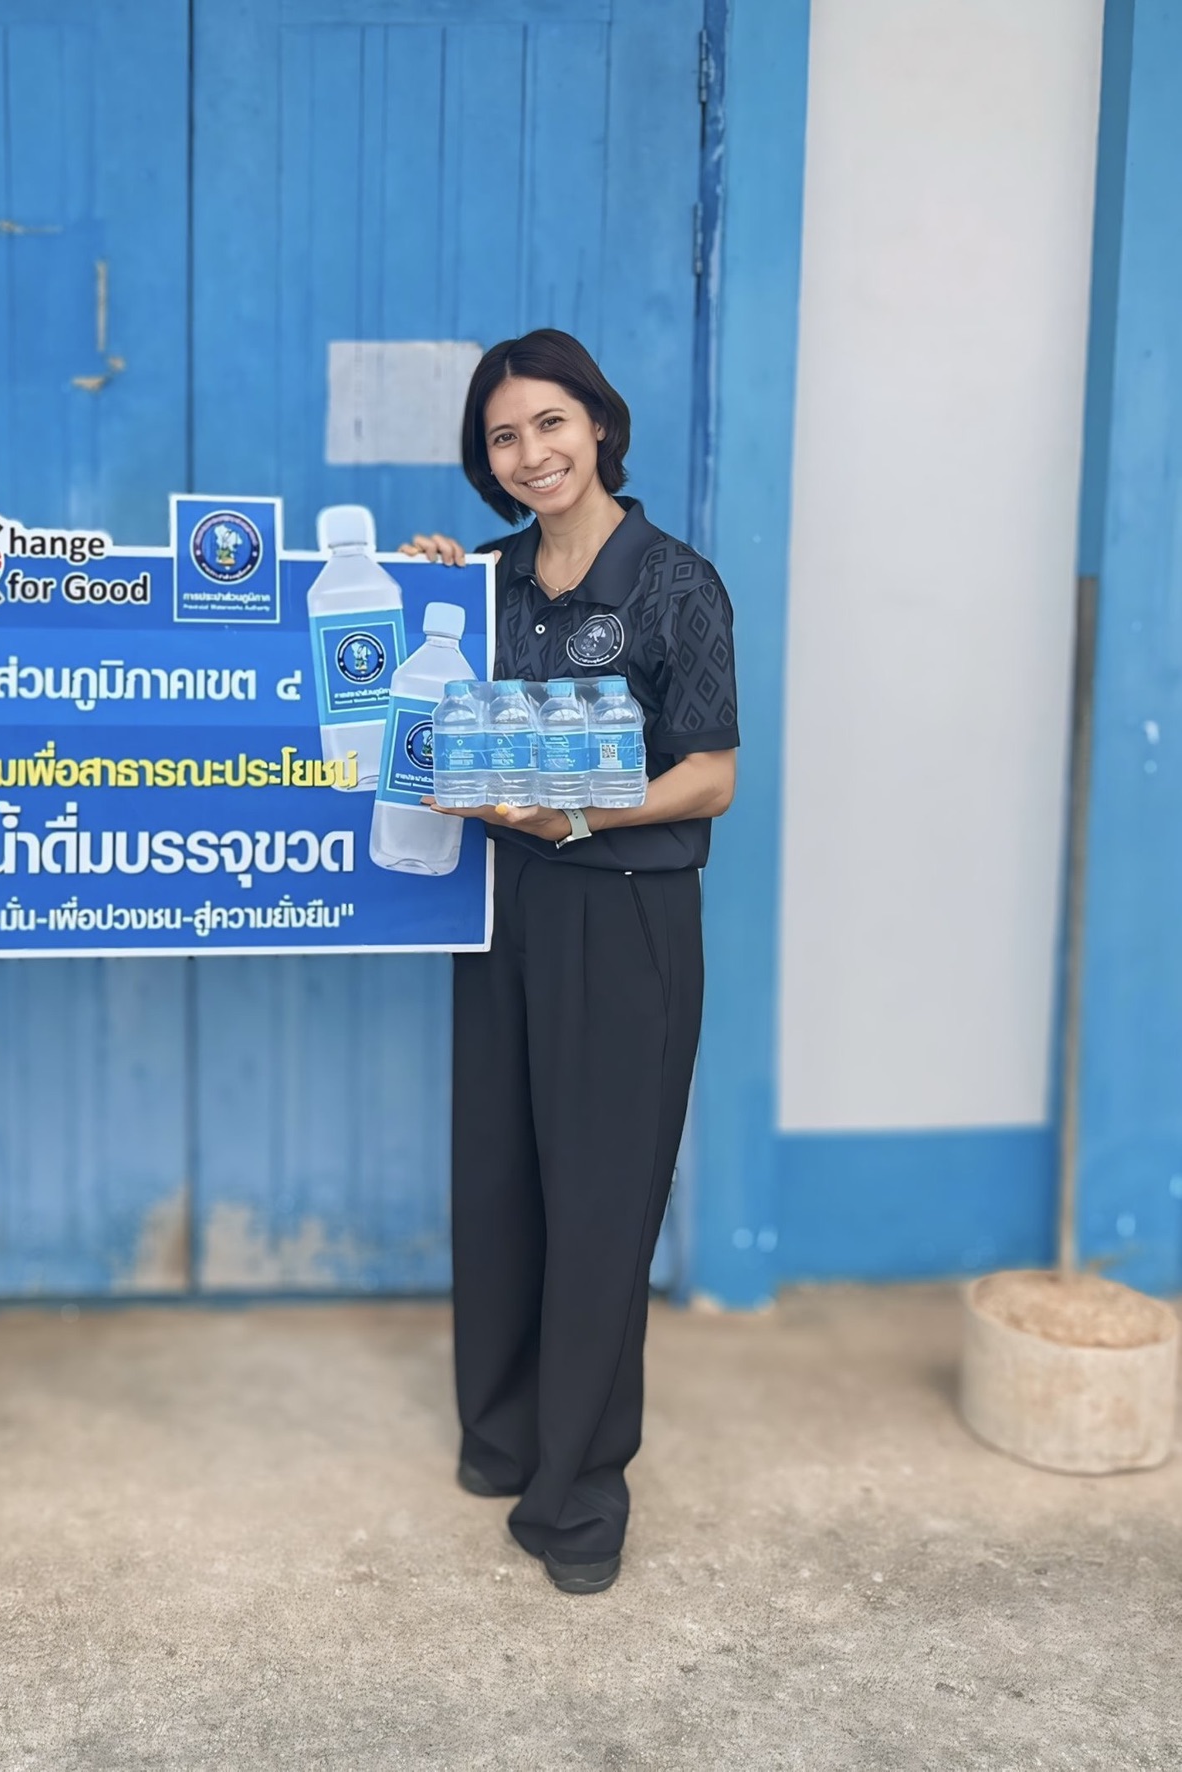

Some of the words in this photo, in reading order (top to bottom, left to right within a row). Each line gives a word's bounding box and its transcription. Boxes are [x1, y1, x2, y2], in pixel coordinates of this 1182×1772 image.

[8, 573, 54, 602] for
[64, 574, 149, 603] Good
[276, 670, 303, 700] ๔
